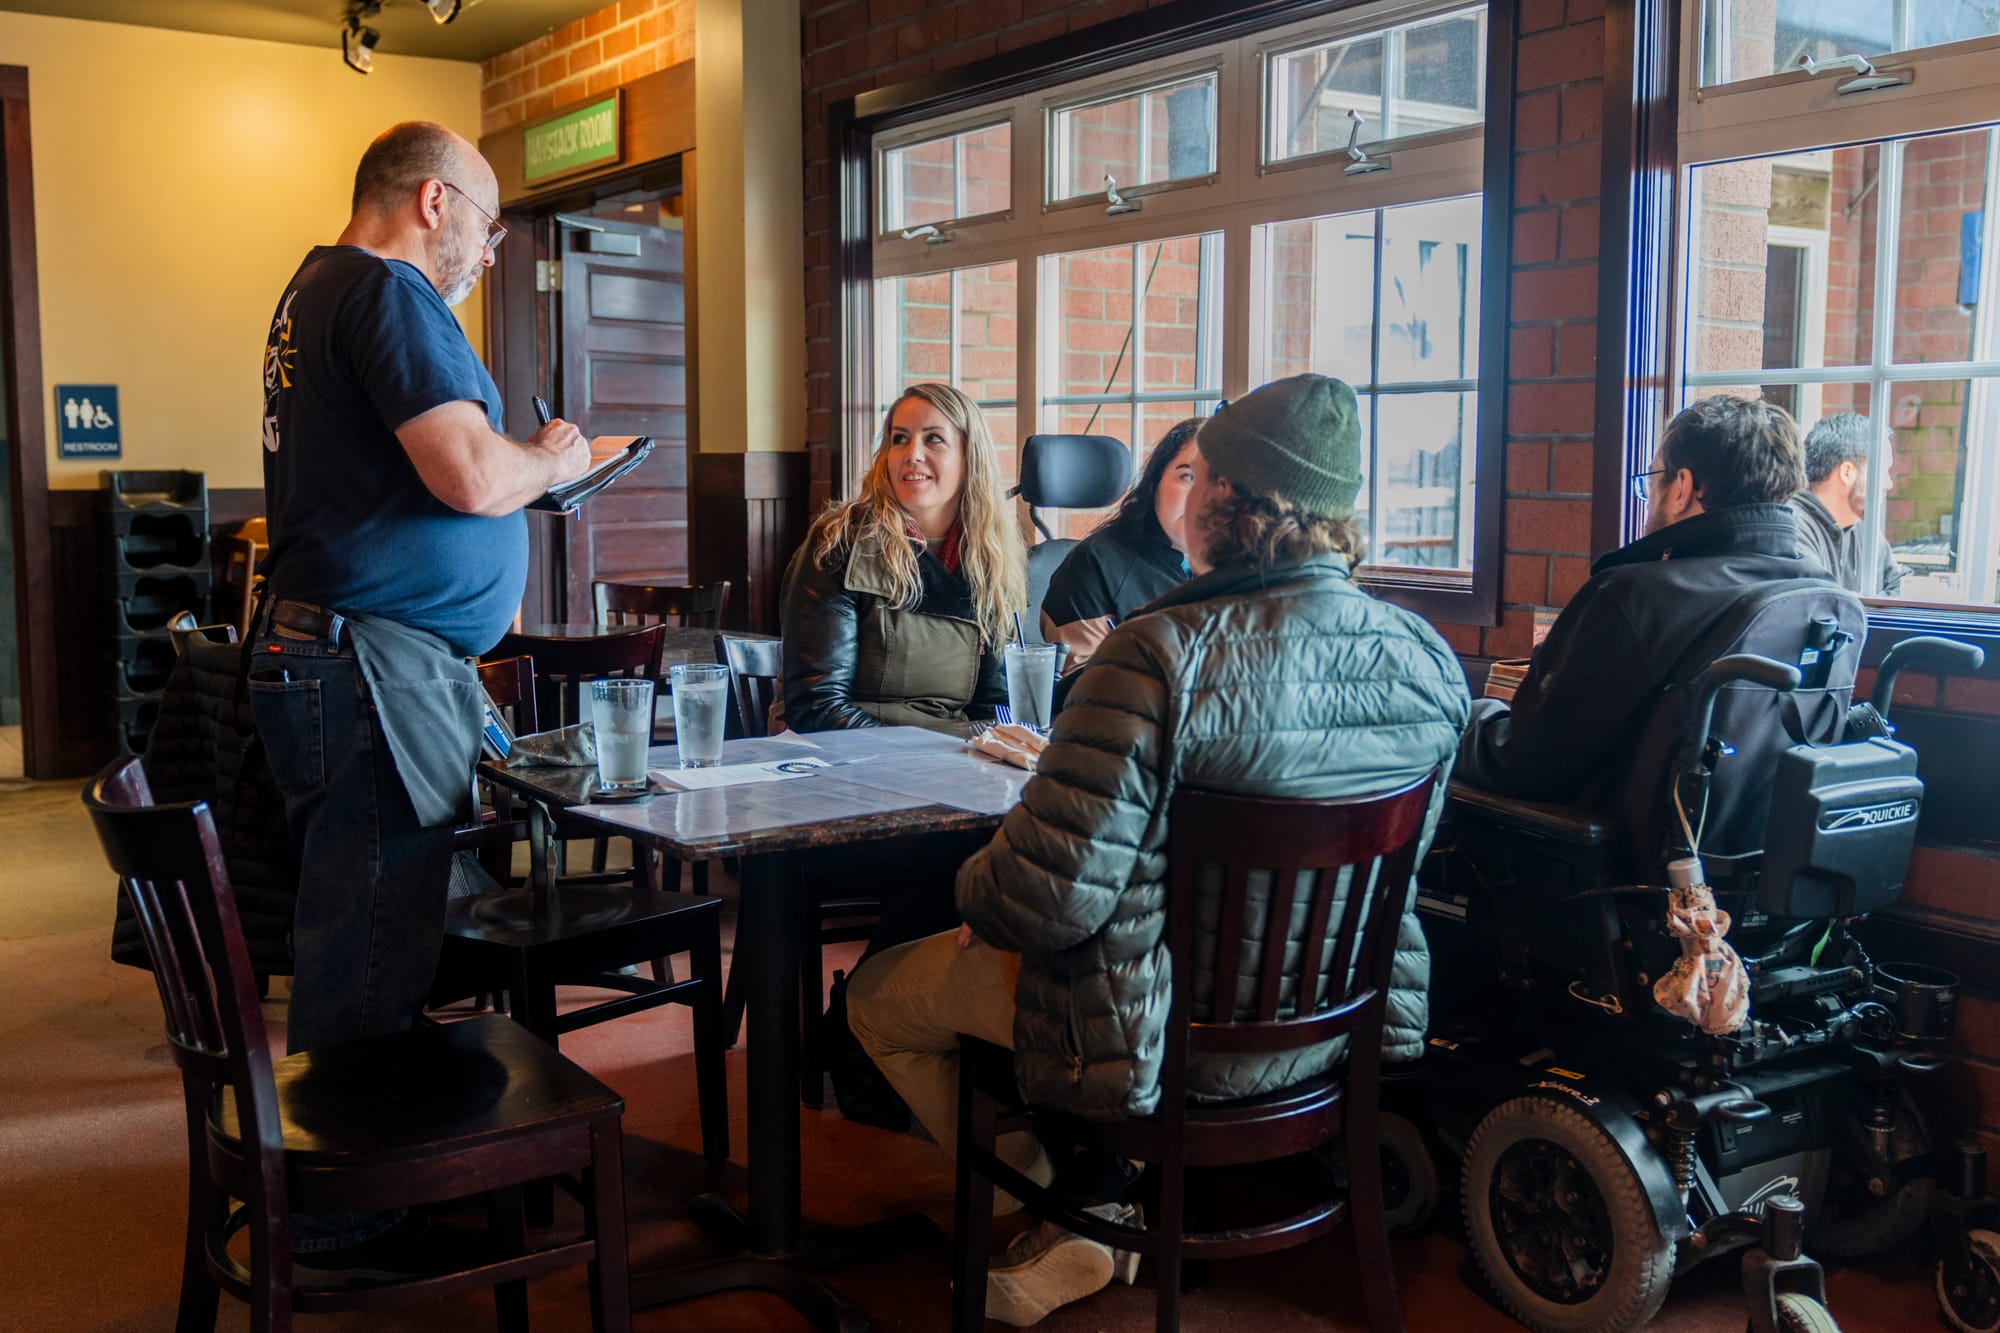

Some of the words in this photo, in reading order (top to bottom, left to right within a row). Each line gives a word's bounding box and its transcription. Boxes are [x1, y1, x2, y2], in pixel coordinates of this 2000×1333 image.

[580, 109, 612, 151] ROOM
[63, 442, 118, 452] RESTROOM
[1869, 804, 1912, 824] QUICKIE
